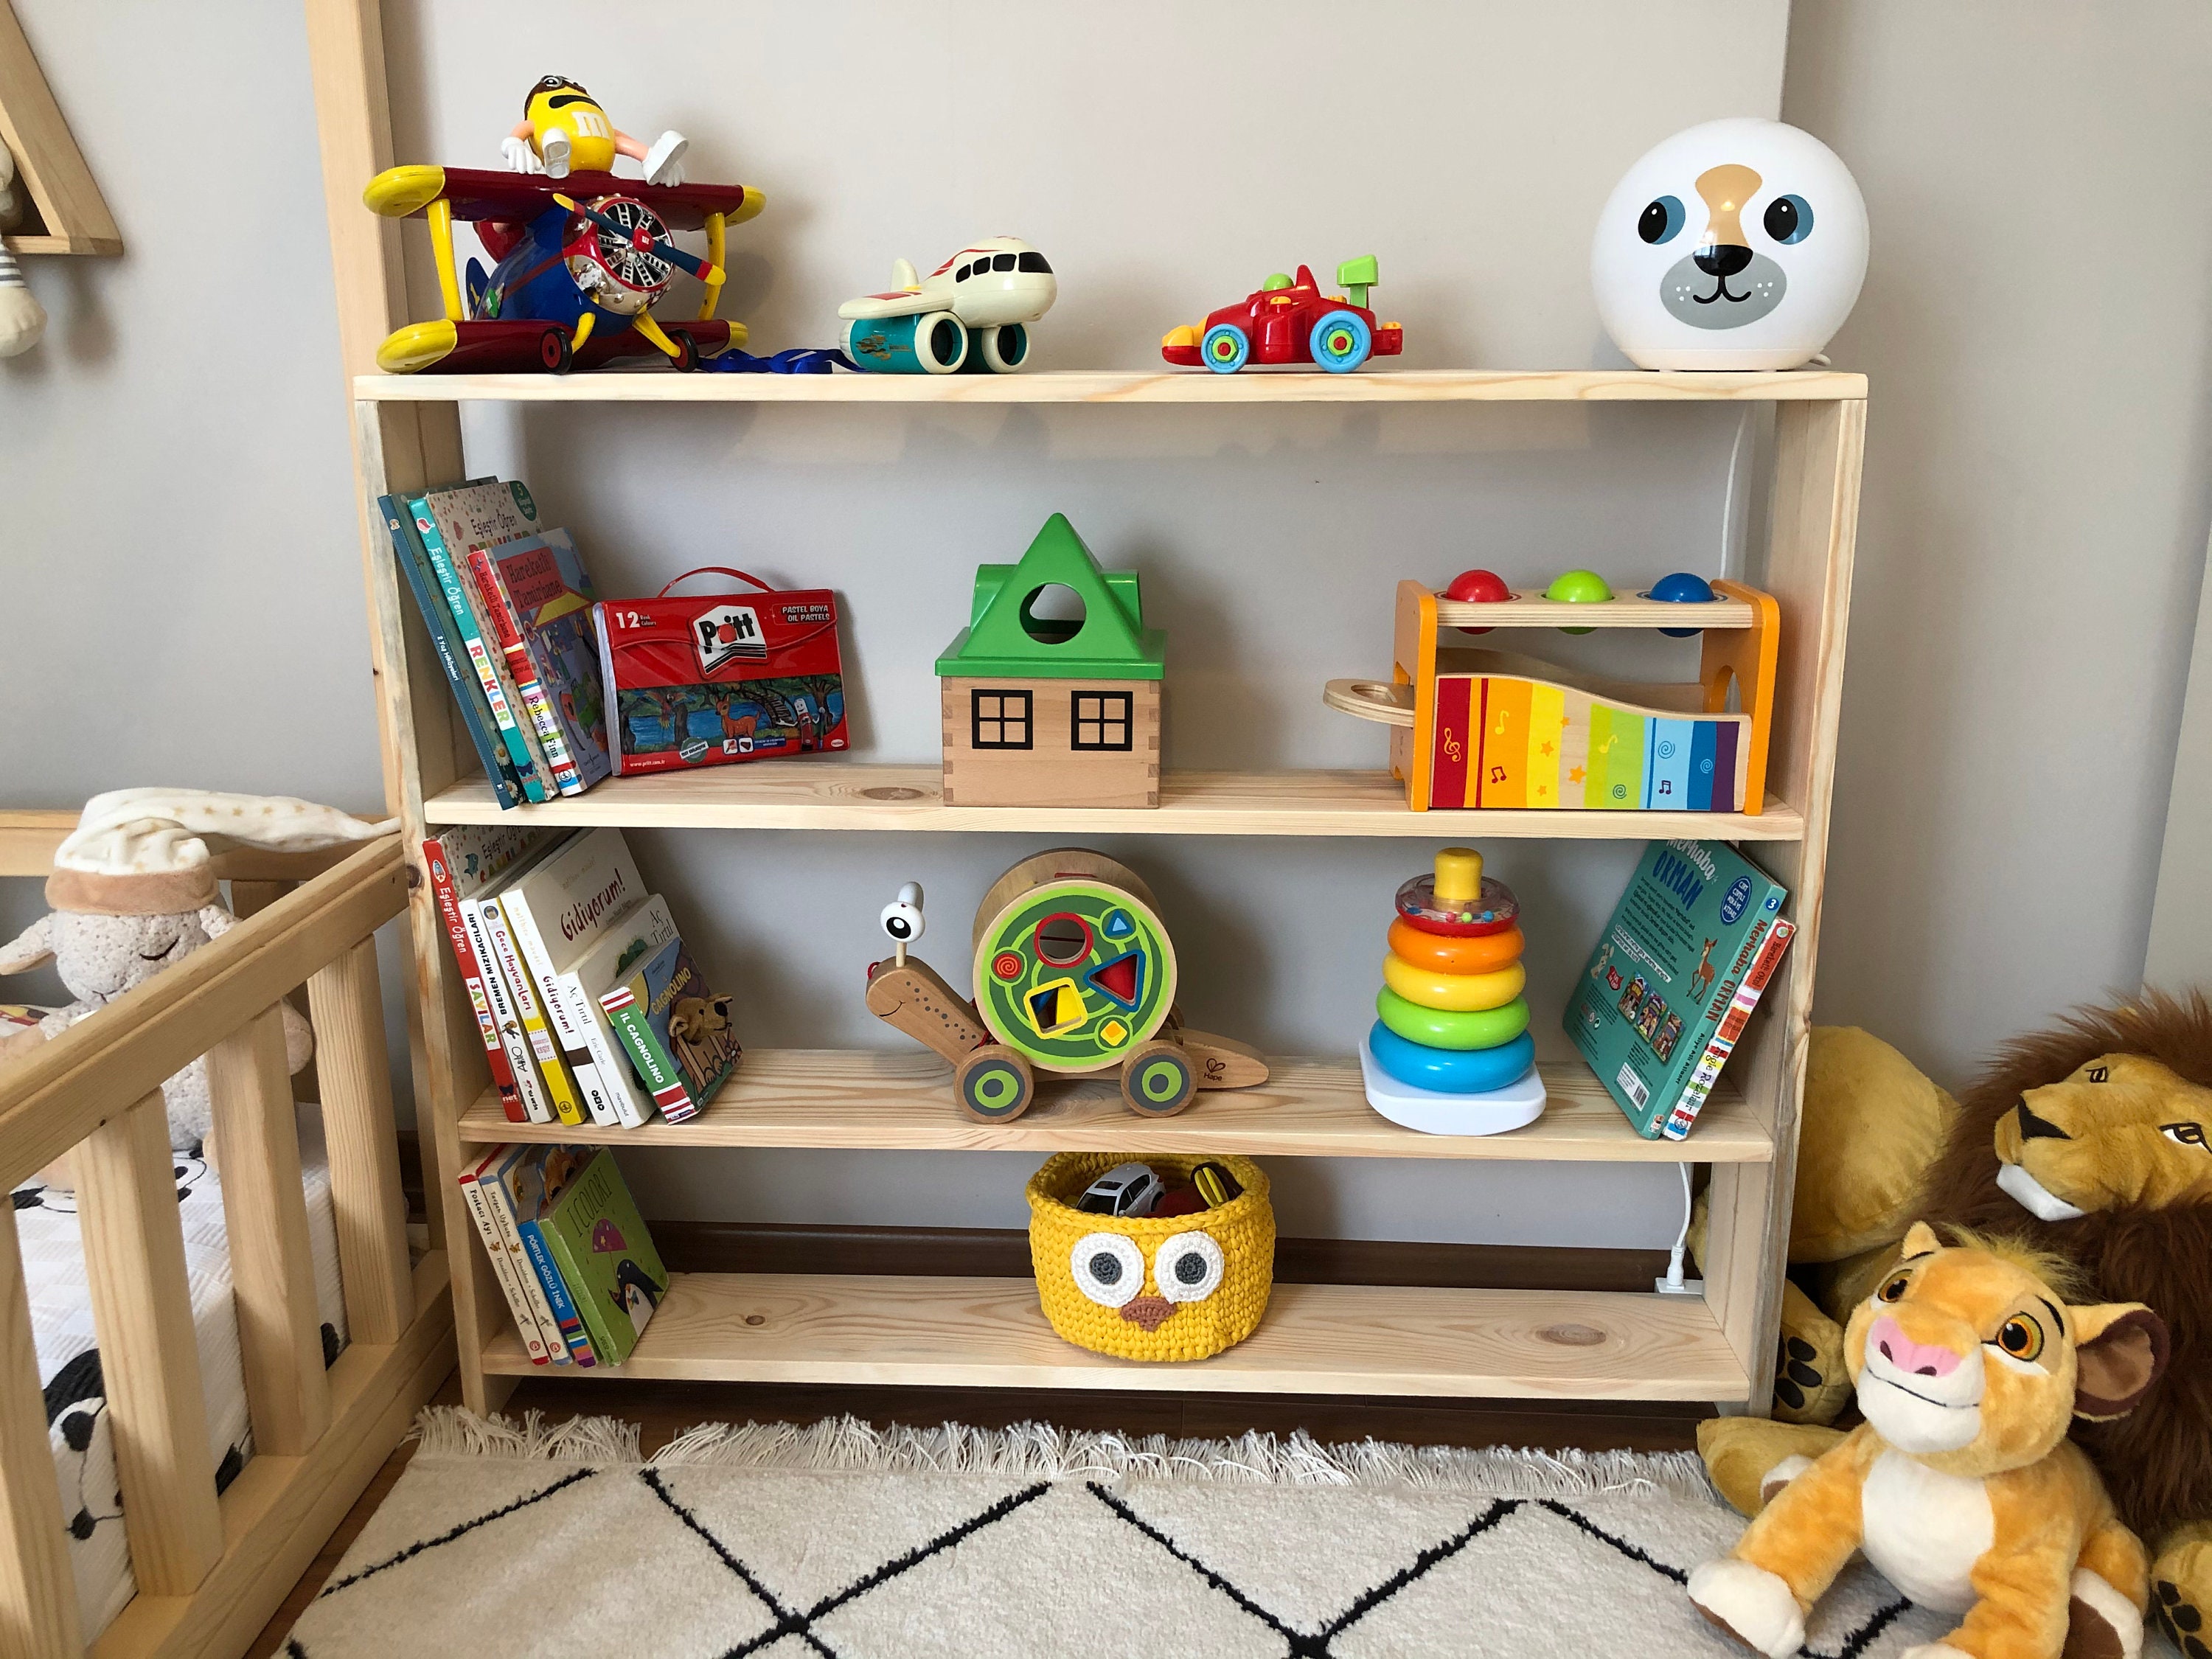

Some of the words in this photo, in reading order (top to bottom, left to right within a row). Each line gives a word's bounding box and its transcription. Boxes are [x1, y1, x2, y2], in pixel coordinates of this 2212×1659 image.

[572, 112, 611, 139] m
[429, 546, 452, 584] Eşleştir
[447, 587, 465, 616] Öğren
[616, 611, 640, 628] 12
[698, 613, 755, 654] Ptt
[782, 605, 807, 613] PASTEL
[470, 645, 510, 723] RENKLER
[529, 695, 549, 737] Rebecca
[546, 737, 559, 758] Finn
[561, 868, 626, 942] Gidiyorum!
[1652, 850, 1703, 911] ORMAN
[1767, 900, 1776, 908] 3
[439, 887, 458, 923] Eşleştir
[452, 926, 467, 953] Öğren
[467, 913, 493, 974] MIZIKACILARI
[650, 909, 663, 928] Aç
[495, 931, 509, 953] Gece
[505, 954, 532, 1010] Hayvanları
[1731, 919, 1768, 975] Merhaba
[470, 984, 497, 1043] SAYILAR
[489, 976, 507, 1015] BREMEN
[543, 975, 575, 1034] Gidiyorum!
[568, 985, 578, 999] Aç
[651, 967, 692, 1015] CAGNOLINO
[1705, 980, 1736, 1021] ORMAN
[619, 1012, 628, 1024] IL
[627, 1023, 664, 1084] CAGNOLINO
[1203, 1073, 1222, 1081] Hape
[1686, 1072, 1712, 1111] Rozelaar
[470, 1189, 485, 1218] Postacı
[482, 1220, 492, 1235] Ayı
[526, 1234, 546, 1265] PÖRTLEK
[540, 1265, 558, 1290] GÖZLÜ
